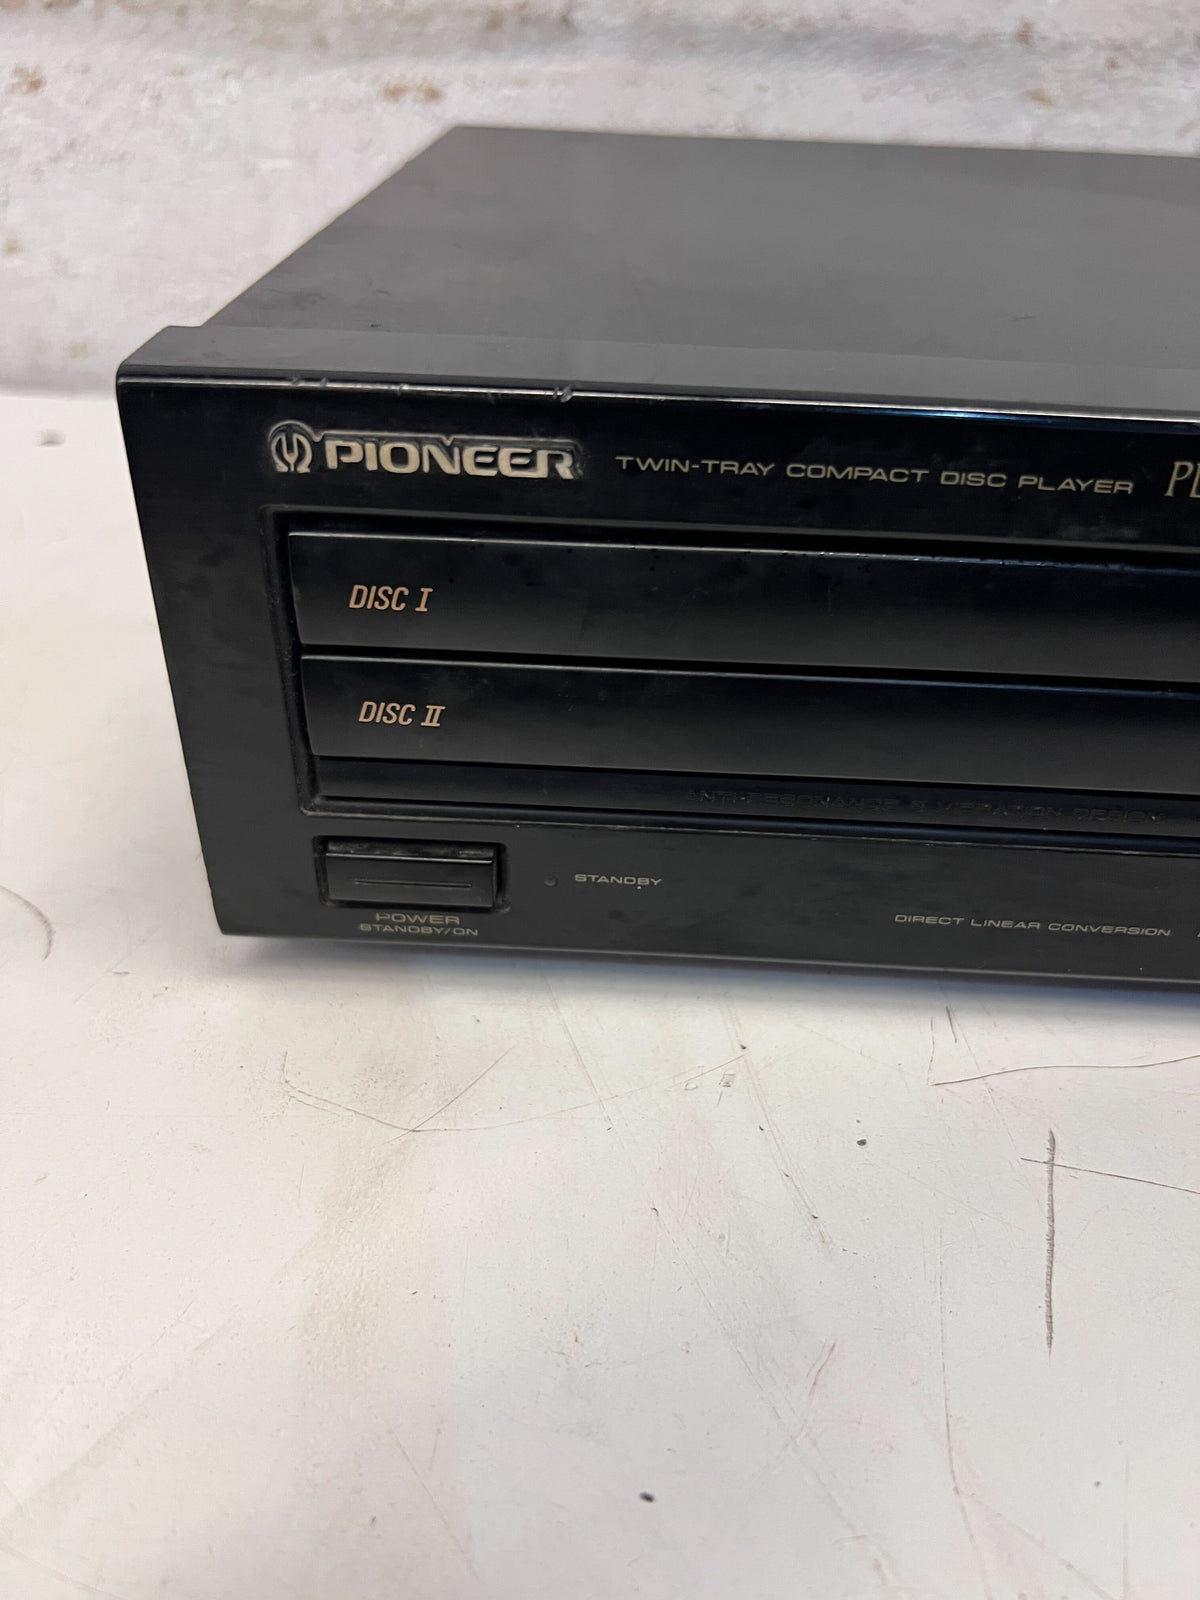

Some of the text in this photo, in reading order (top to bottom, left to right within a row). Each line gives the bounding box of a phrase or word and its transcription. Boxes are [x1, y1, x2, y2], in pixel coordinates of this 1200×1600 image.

[324, 440, 574, 479] PIONEER
[616, 456, 1134, 495] TWIN-TRAY COMPACT DISC PLAYER
[349, 584, 433, 612] DISC I
[358, 701, 416, 725] DISC
[574, 873, 662, 887] STANDBY
[359, 923, 478, 937] STANDBY/ON
[376, 912, 460, 926] POWER
[895, 914, 1171, 937] DIRECT LINEAR CONVERSION
